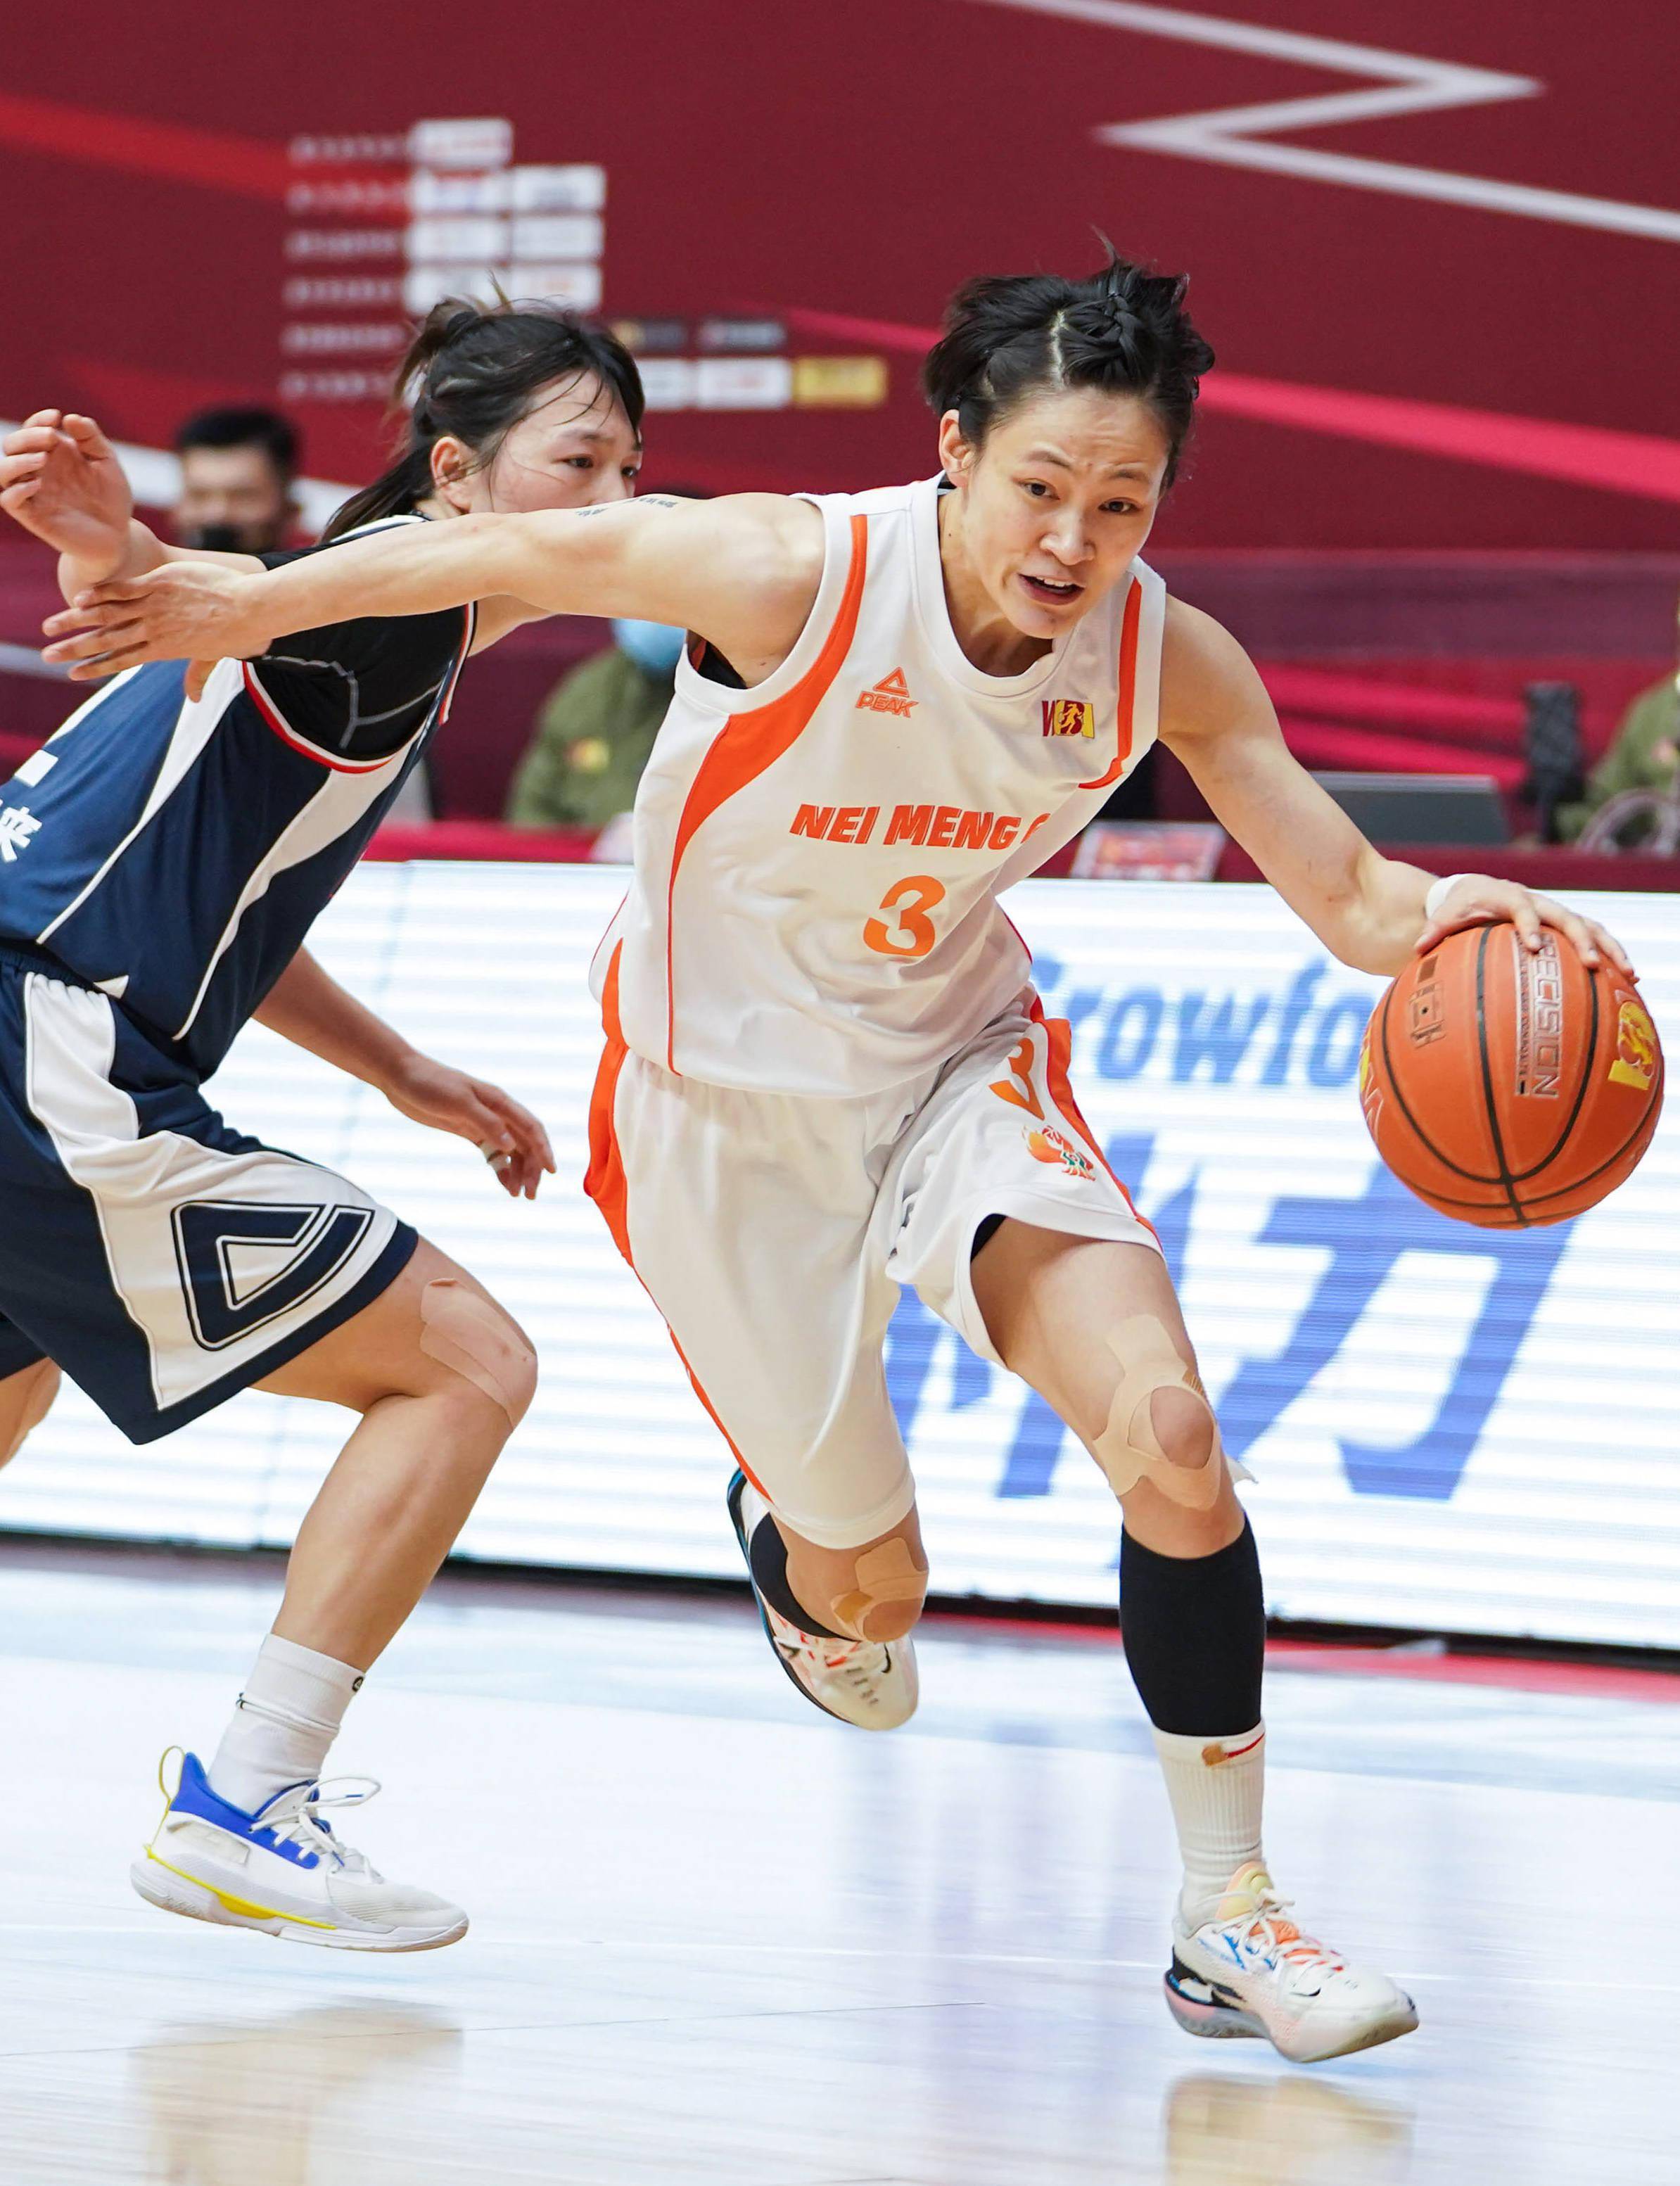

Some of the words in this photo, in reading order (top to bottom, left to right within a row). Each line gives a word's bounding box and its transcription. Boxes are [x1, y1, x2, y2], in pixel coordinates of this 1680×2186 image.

[855, 690, 919, 718] PEAK
[789, 803, 880, 844] NEI
[883, 804, 1022, 851] MENG
[863, 875, 946, 958] 3
[1031, 957, 1372, 1088] rowfo
